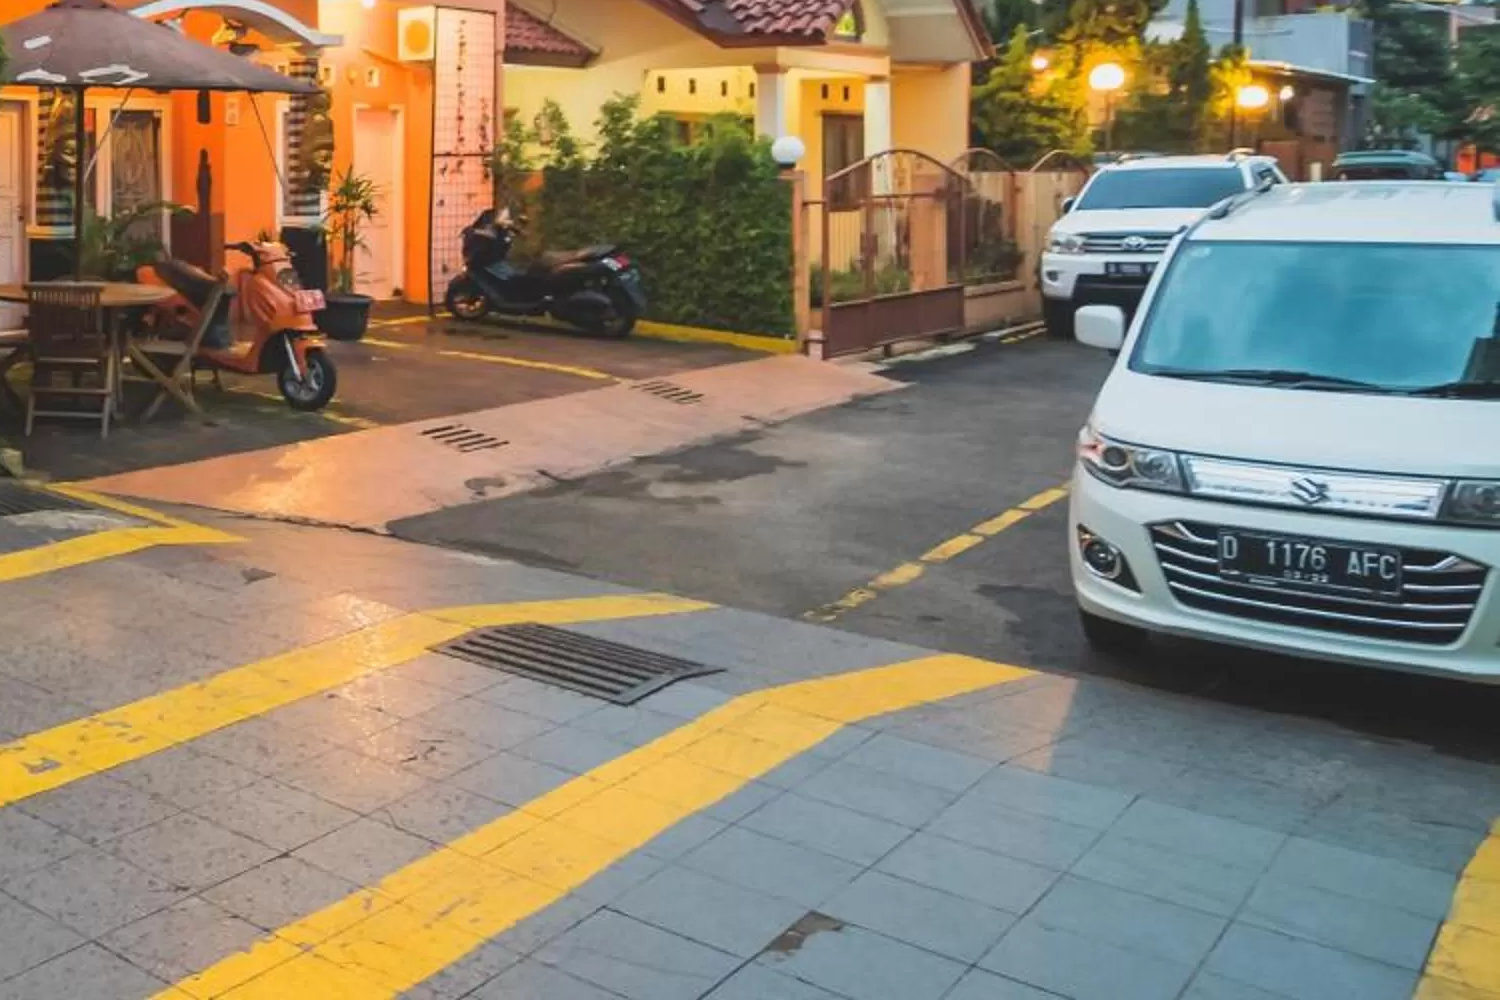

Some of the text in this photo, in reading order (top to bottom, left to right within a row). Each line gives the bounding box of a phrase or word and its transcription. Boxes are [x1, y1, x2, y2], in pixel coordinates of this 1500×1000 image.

[1222, 535, 1238, 560] D
[1266, 540, 1328, 571] 1176
[1347, 550, 1397, 580] AFC
